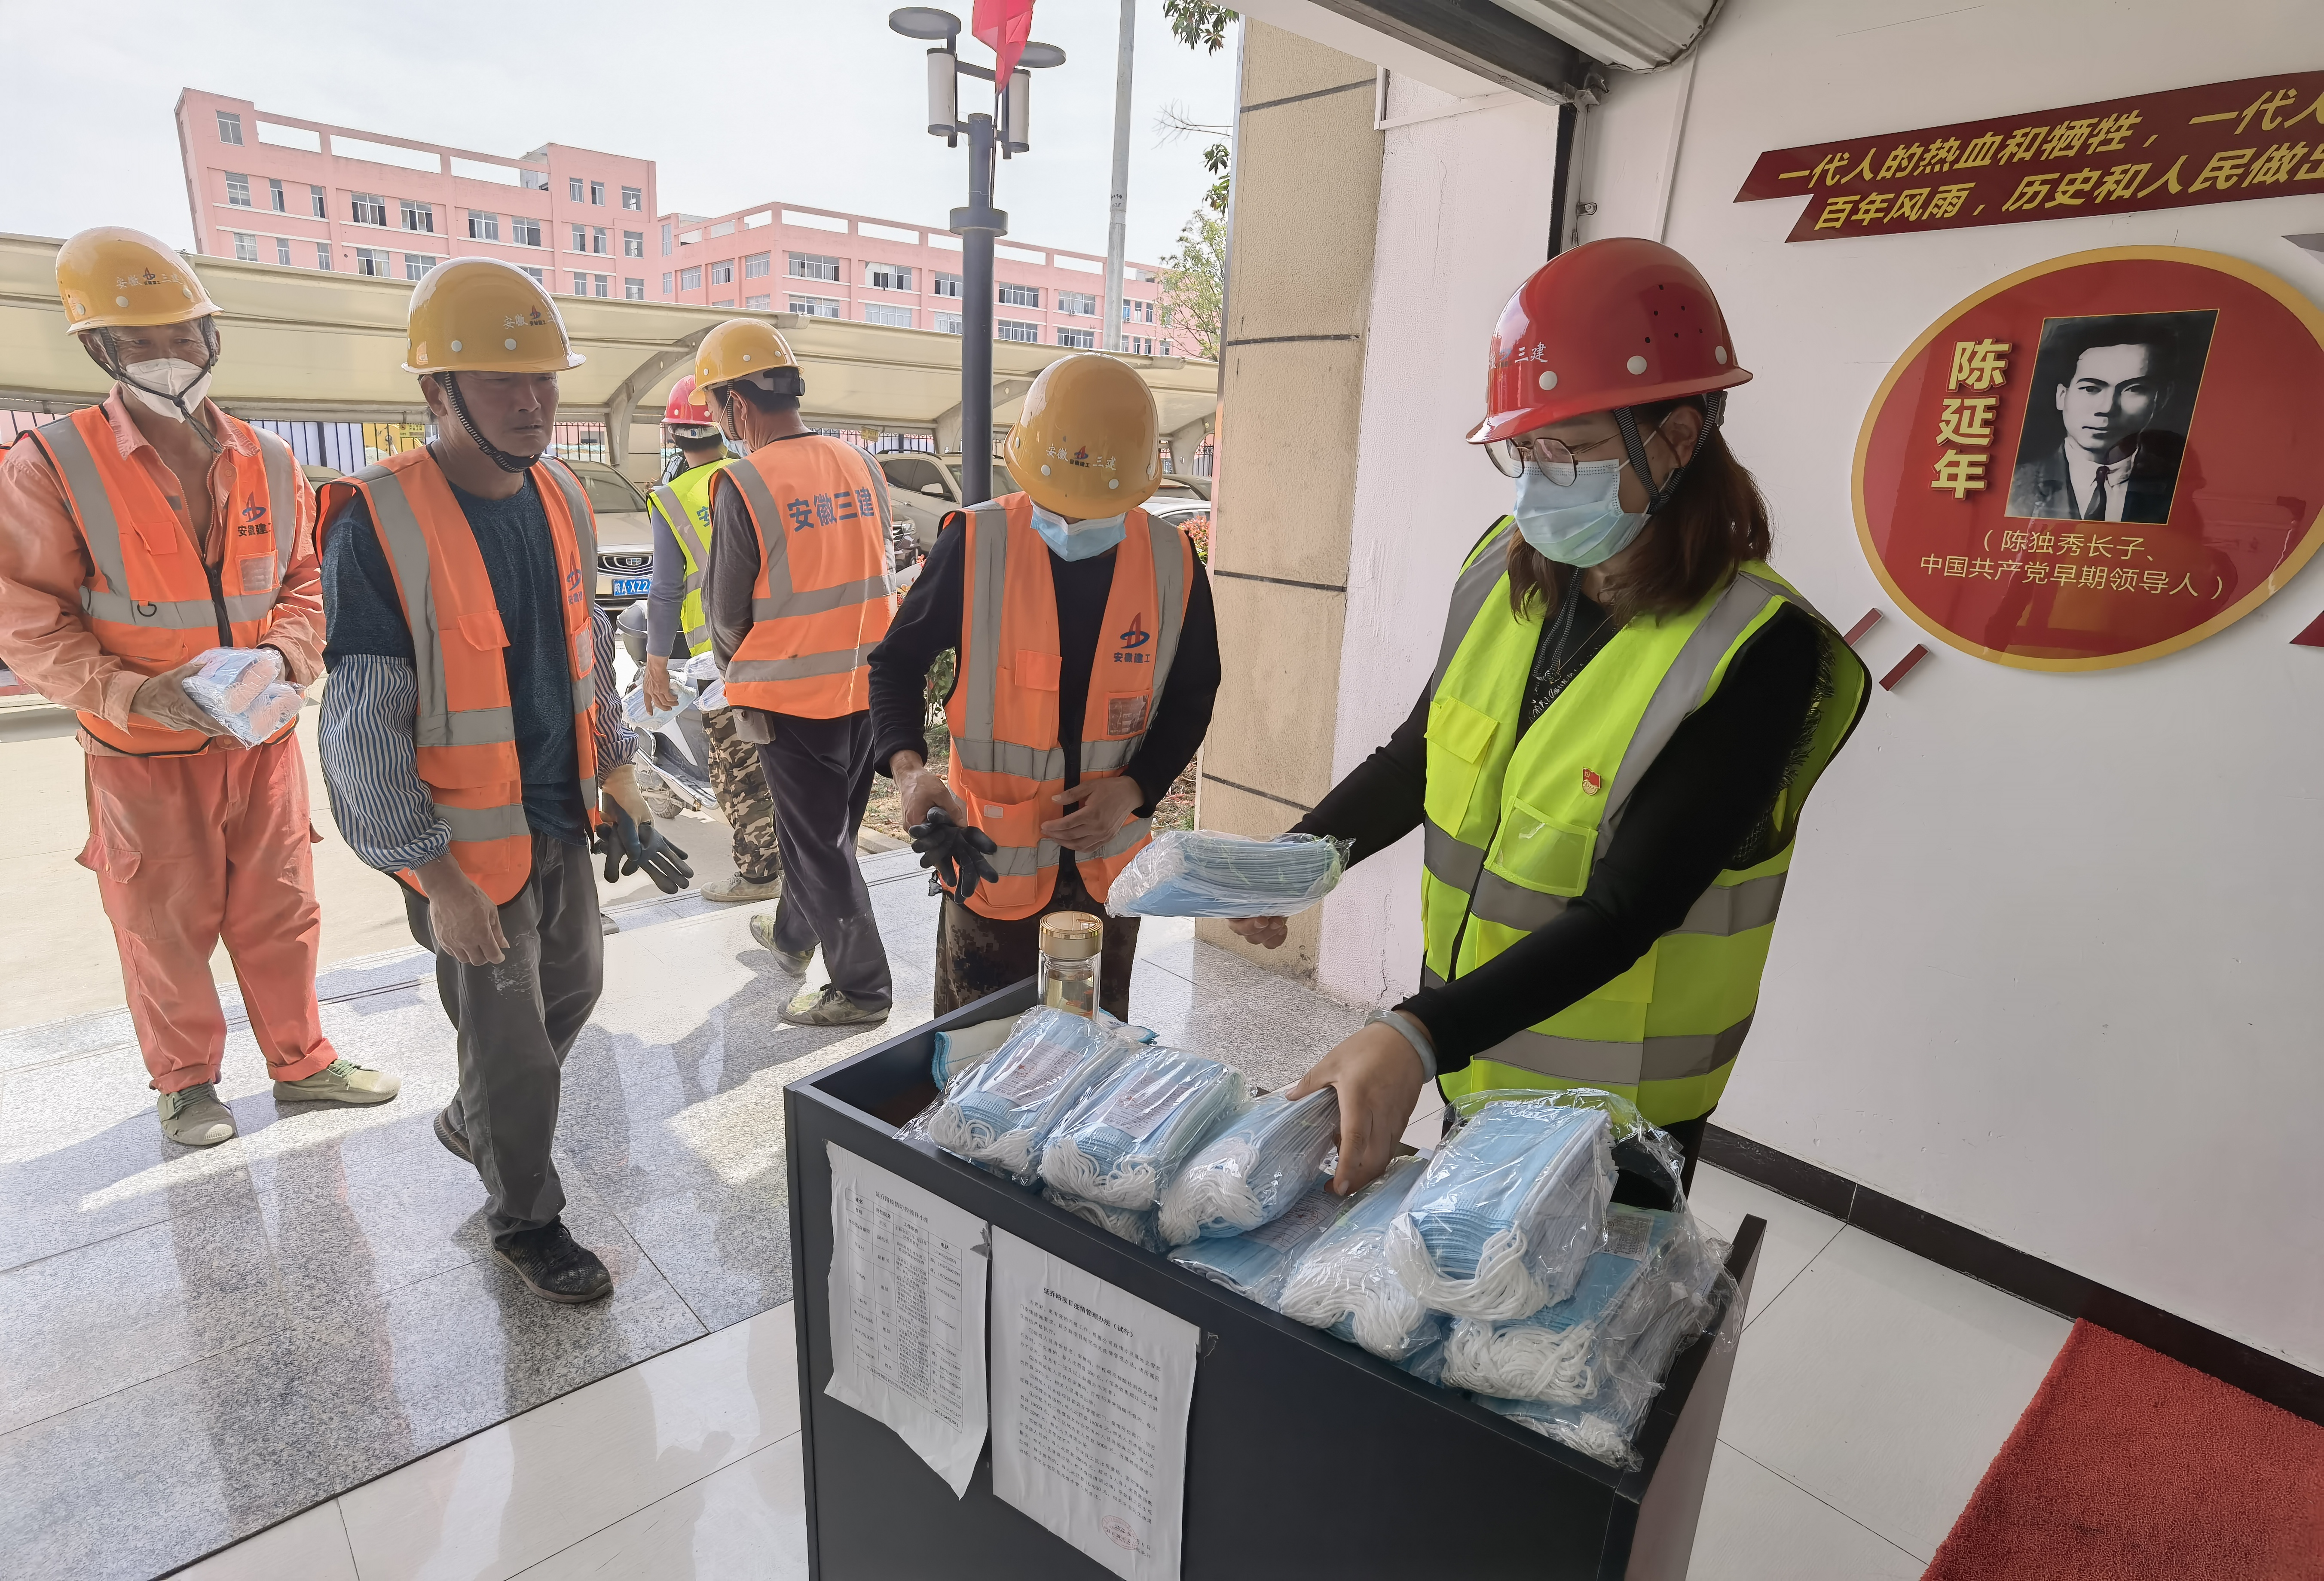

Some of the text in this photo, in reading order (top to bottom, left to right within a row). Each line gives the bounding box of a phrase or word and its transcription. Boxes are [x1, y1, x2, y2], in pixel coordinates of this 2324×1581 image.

[1930, 338, 2010, 499] 陈延年
[787, 486, 875, 532] 安徽三建
[1114, 652, 1150, 663] 安徽建工
